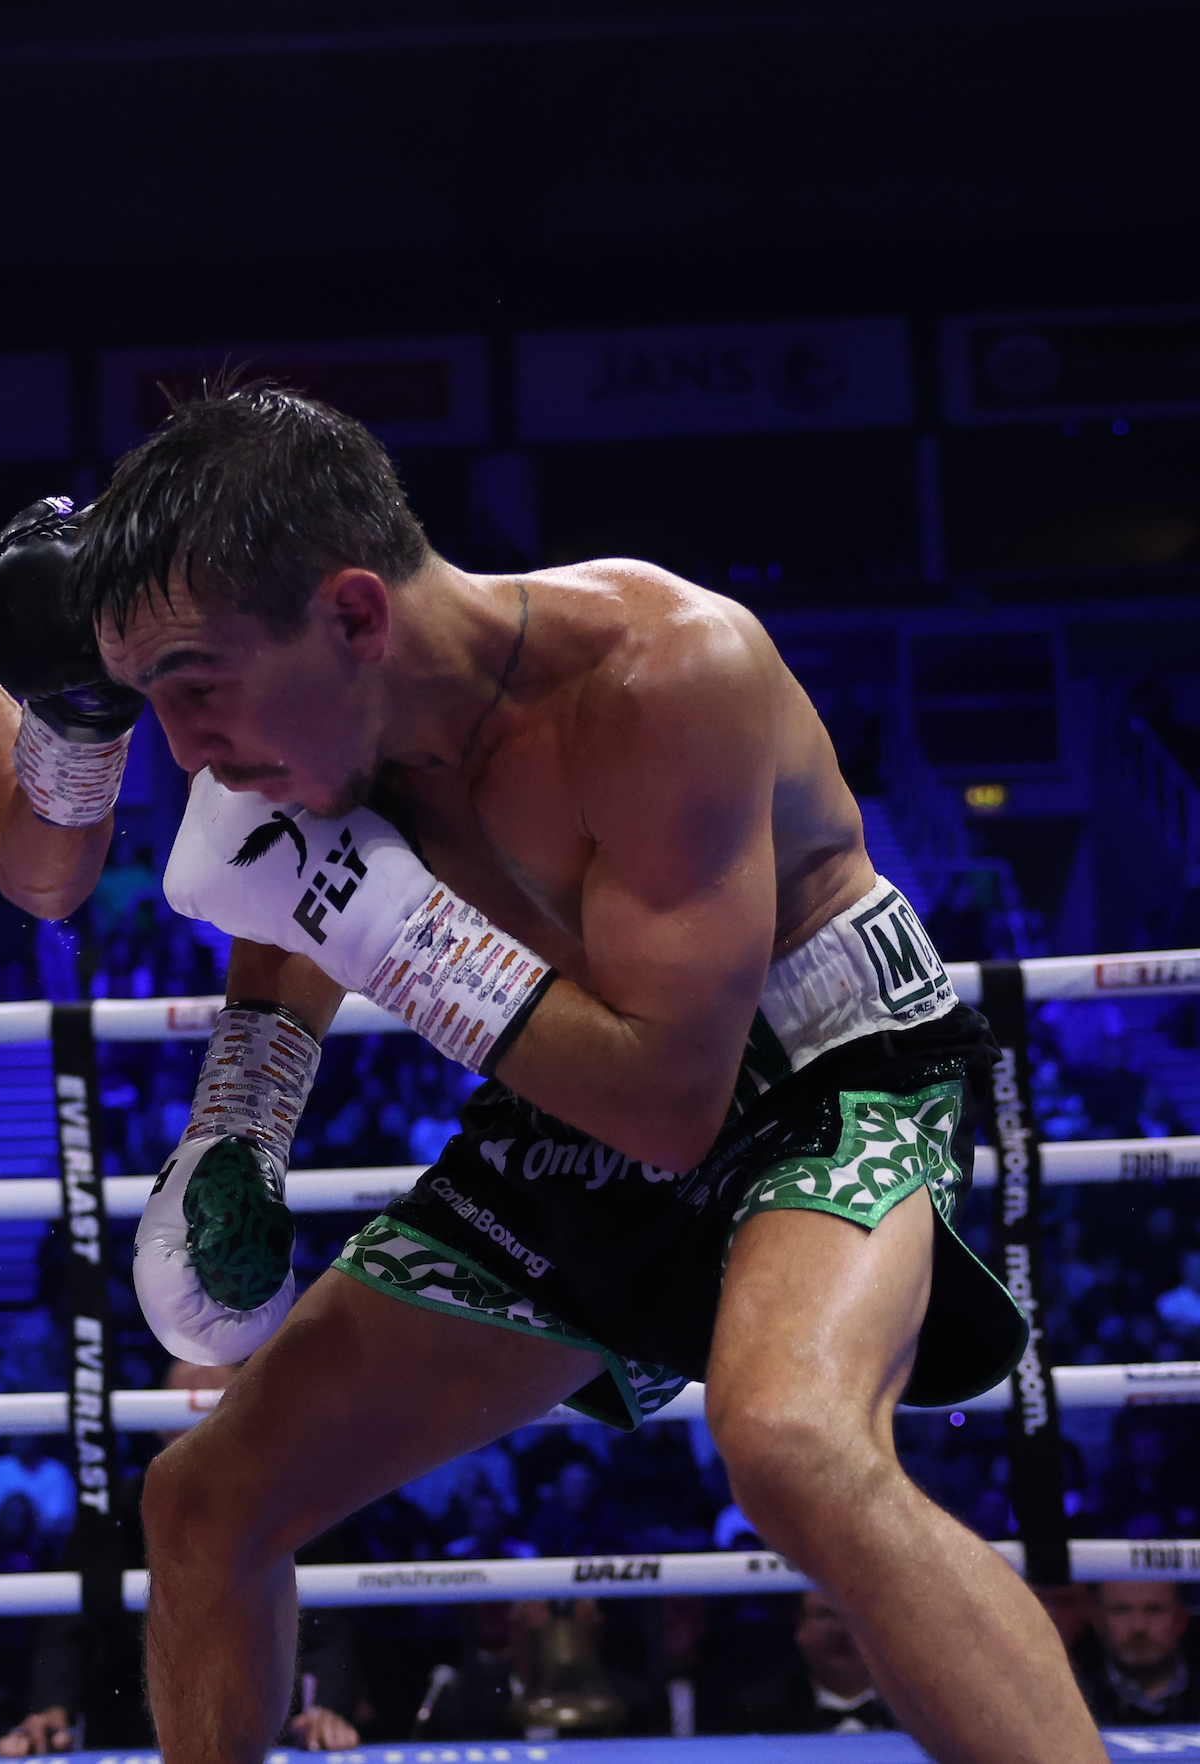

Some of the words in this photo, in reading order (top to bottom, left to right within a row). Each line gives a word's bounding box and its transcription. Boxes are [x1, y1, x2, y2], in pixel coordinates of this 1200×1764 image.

[293, 828, 368, 945] FLY
[55, 1073, 101, 1265] EVERLAST
[73, 1314, 111, 1515] EVERLAST
[574, 1560, 662, 1583] DAZN
